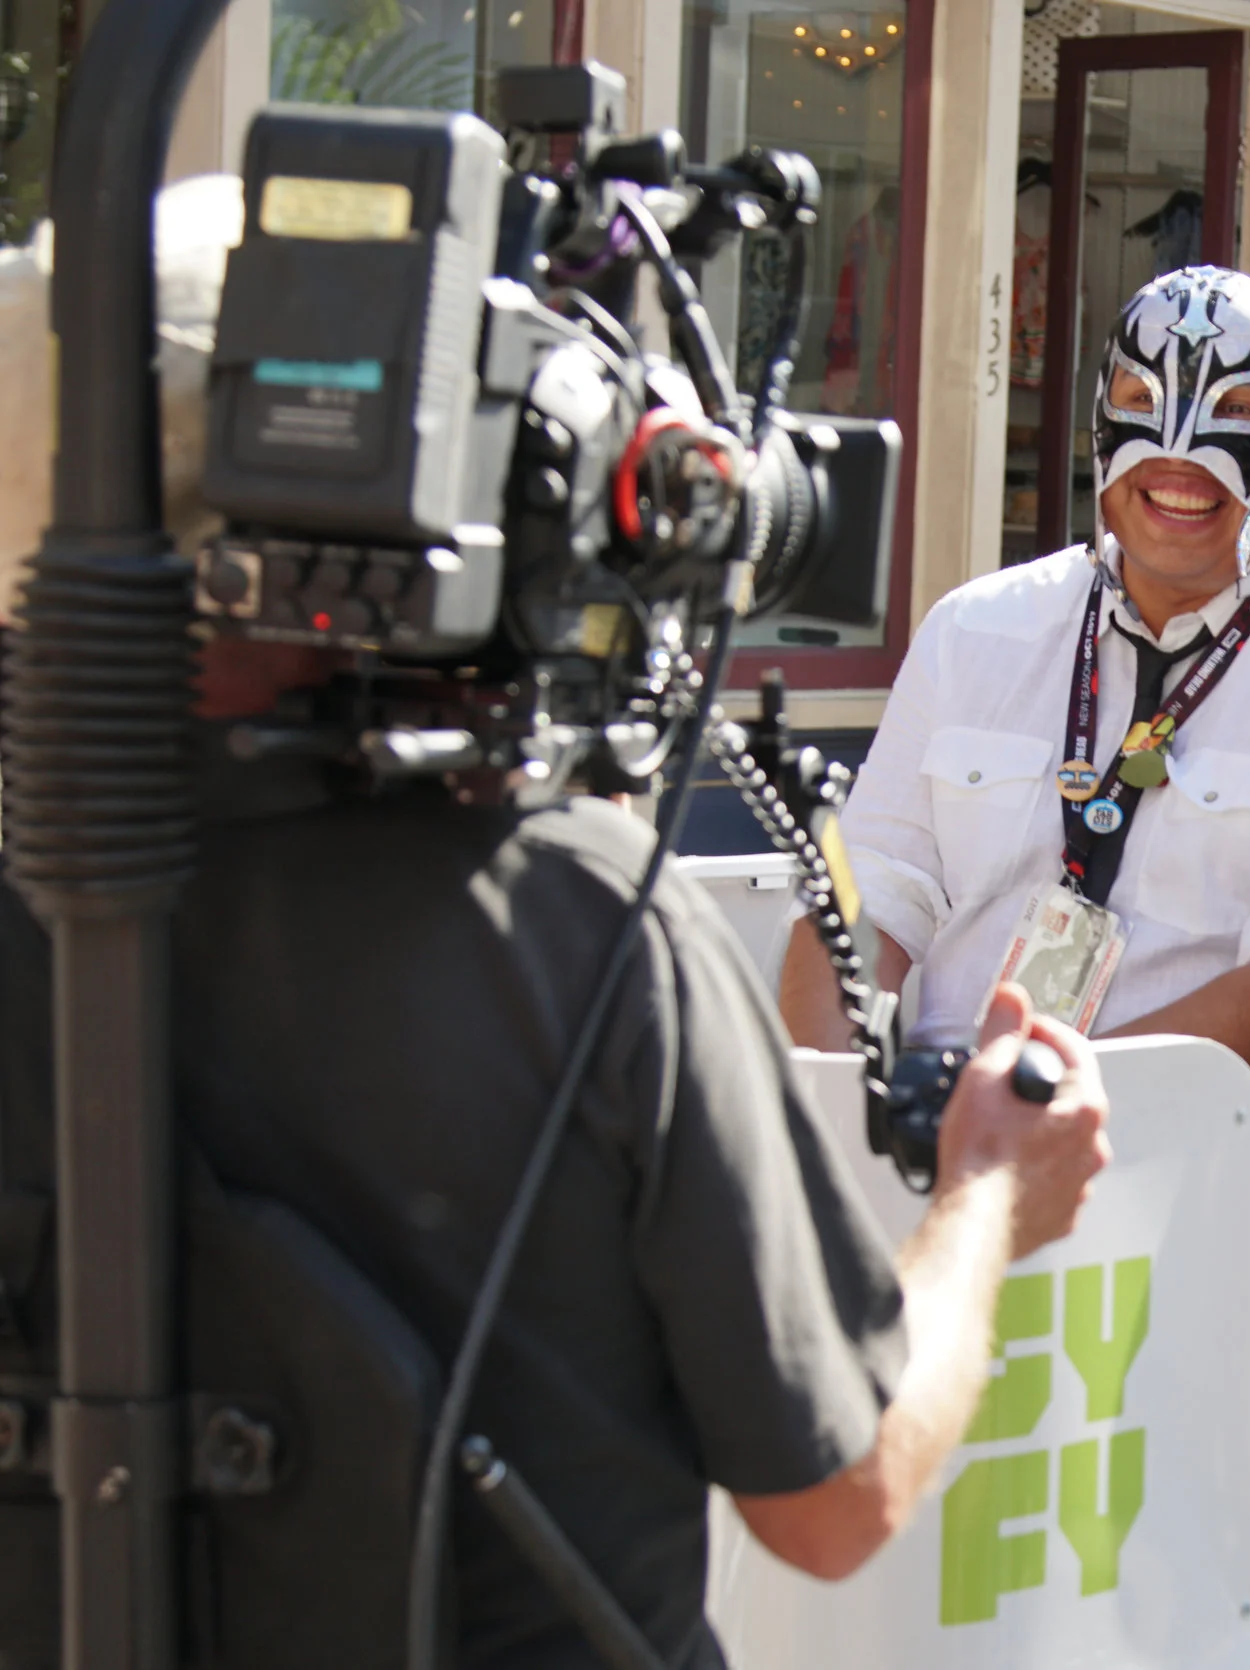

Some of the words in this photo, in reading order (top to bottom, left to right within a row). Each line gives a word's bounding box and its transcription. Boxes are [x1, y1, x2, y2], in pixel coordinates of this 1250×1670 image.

[987, 273, 1002, 397] 435
[1196, 644, 1227, 680] WALKING
[1182, 673, 1204, 698] DEAD
[1104, 780, 1124, 803] 201
[1022, 896, 1040, 922] 2017
[938, 1426, 1146, 1628] FY
